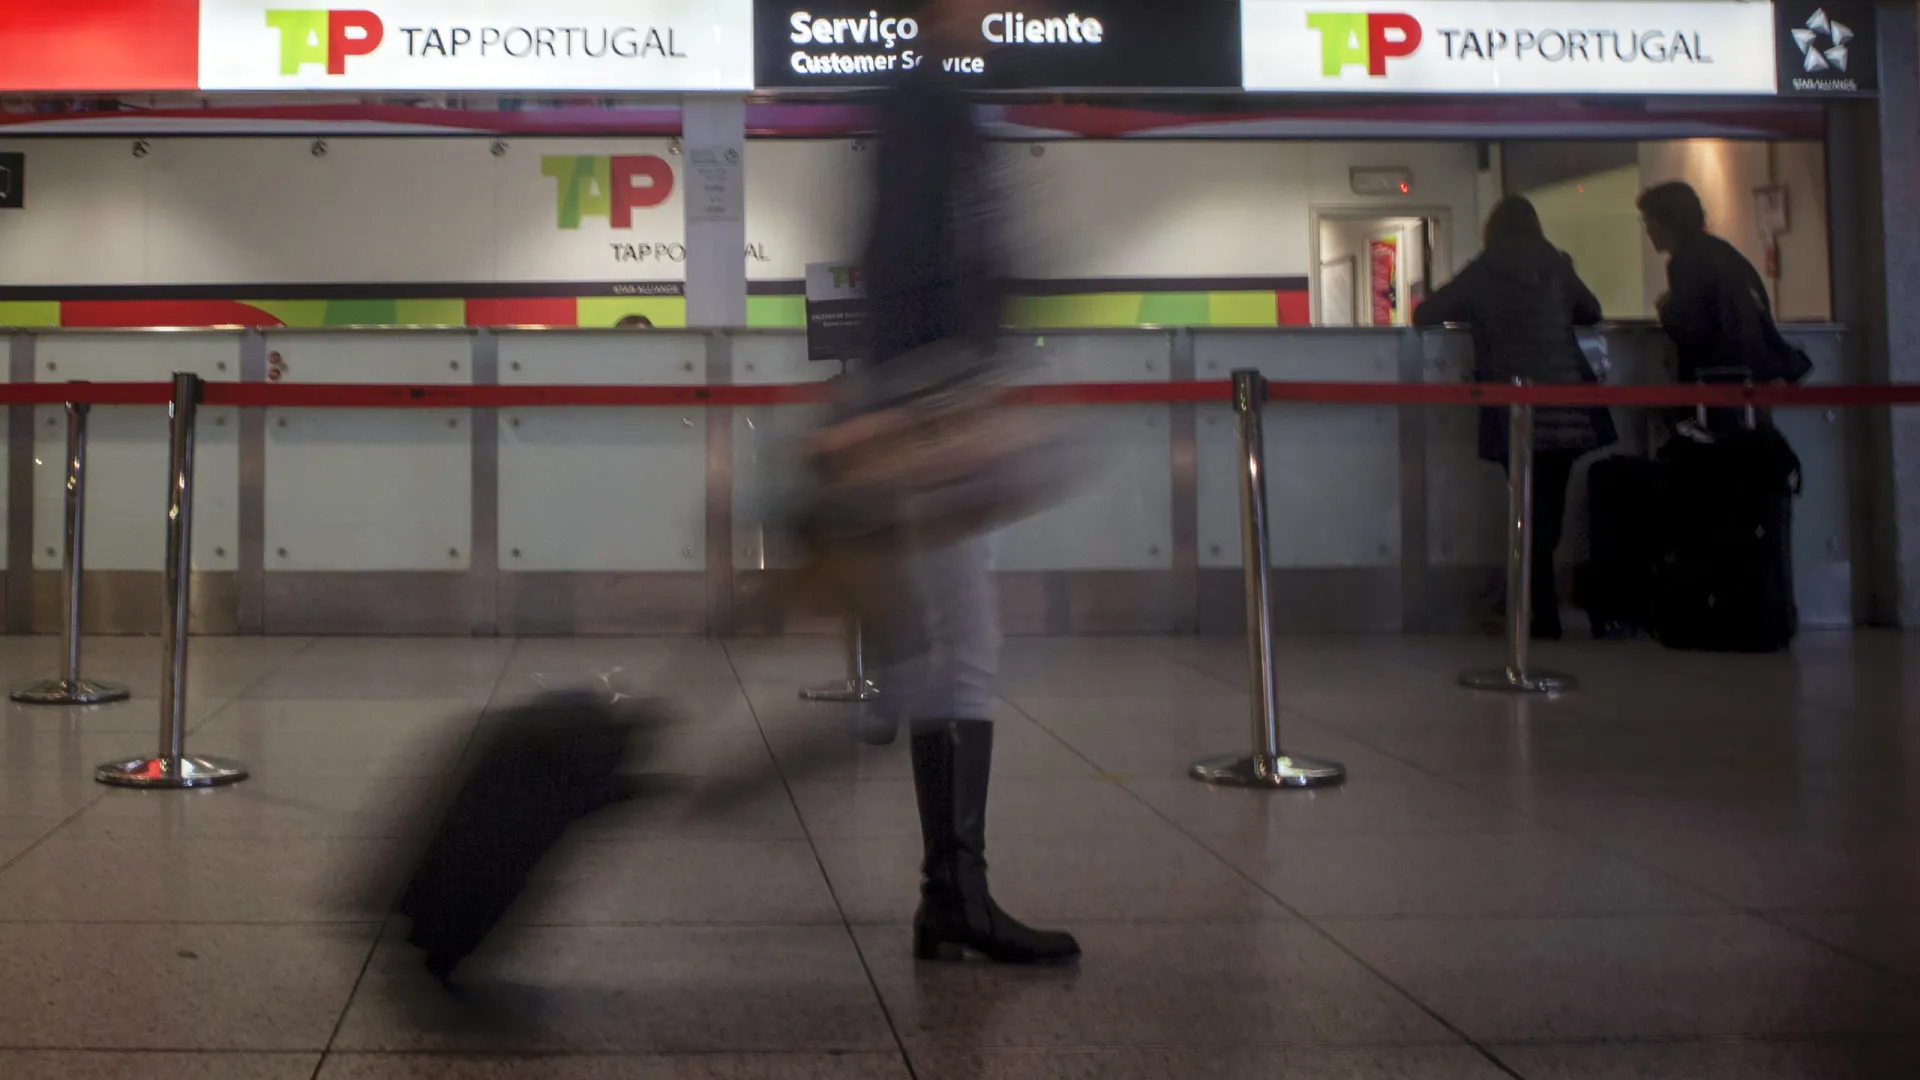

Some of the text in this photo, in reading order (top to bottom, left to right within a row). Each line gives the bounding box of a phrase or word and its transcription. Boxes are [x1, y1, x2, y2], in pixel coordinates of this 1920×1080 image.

[266, 9, 384, 75] TAP
[399, 26, 688, 58] TAP PORTUGAL
[790, 10, 1103, 48] Serviço Cliente
[1306, 12, 1422, 77] TAP
[1436, 28, 1713, 63] TAP PORTUGAL
[791, 50, 984, 74] Customer Svice
[541, 155, 674, 229] TAP
[610, 243, 651, 262] TAP
